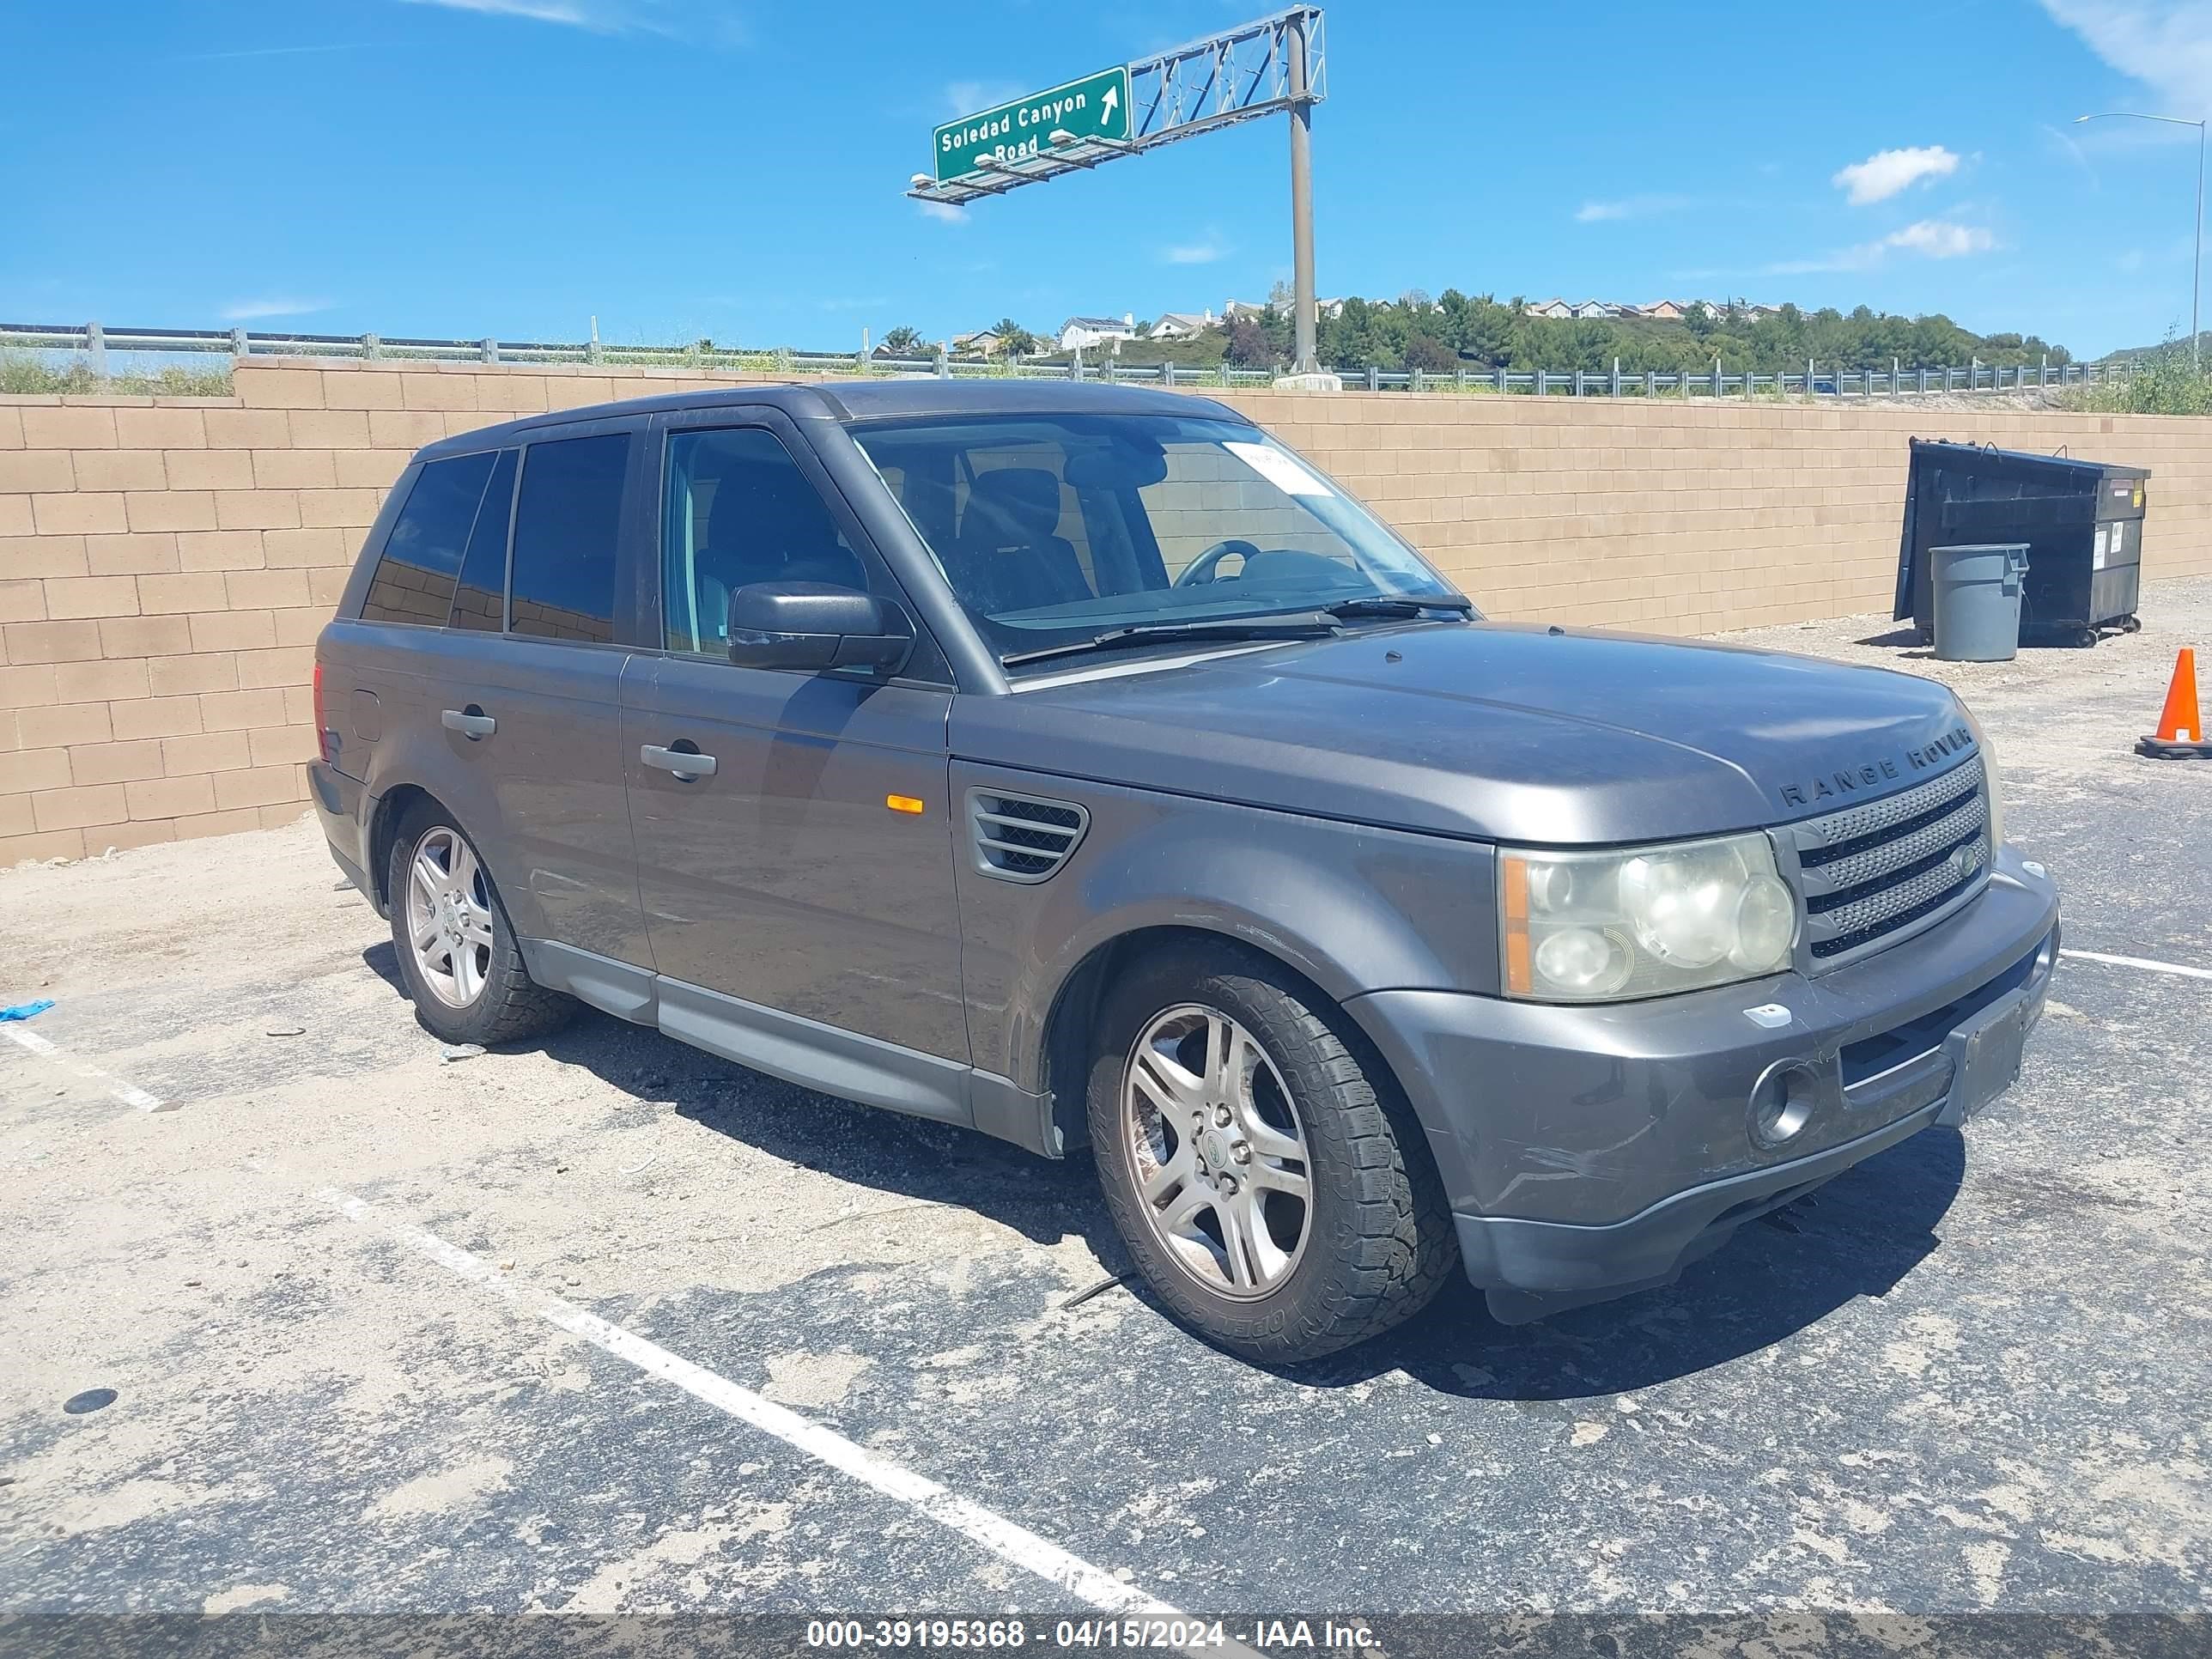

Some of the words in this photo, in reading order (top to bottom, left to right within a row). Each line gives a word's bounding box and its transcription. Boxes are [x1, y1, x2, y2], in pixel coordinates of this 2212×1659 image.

[942, 113, 1010, 152] Soledad
[1018, 93, 1086, 127] Canyon
[994, 133, 1038, 161] Road
[1778, 757, 1899, 807] RANGE
[1905, 726, 1973, 769] ROVER
